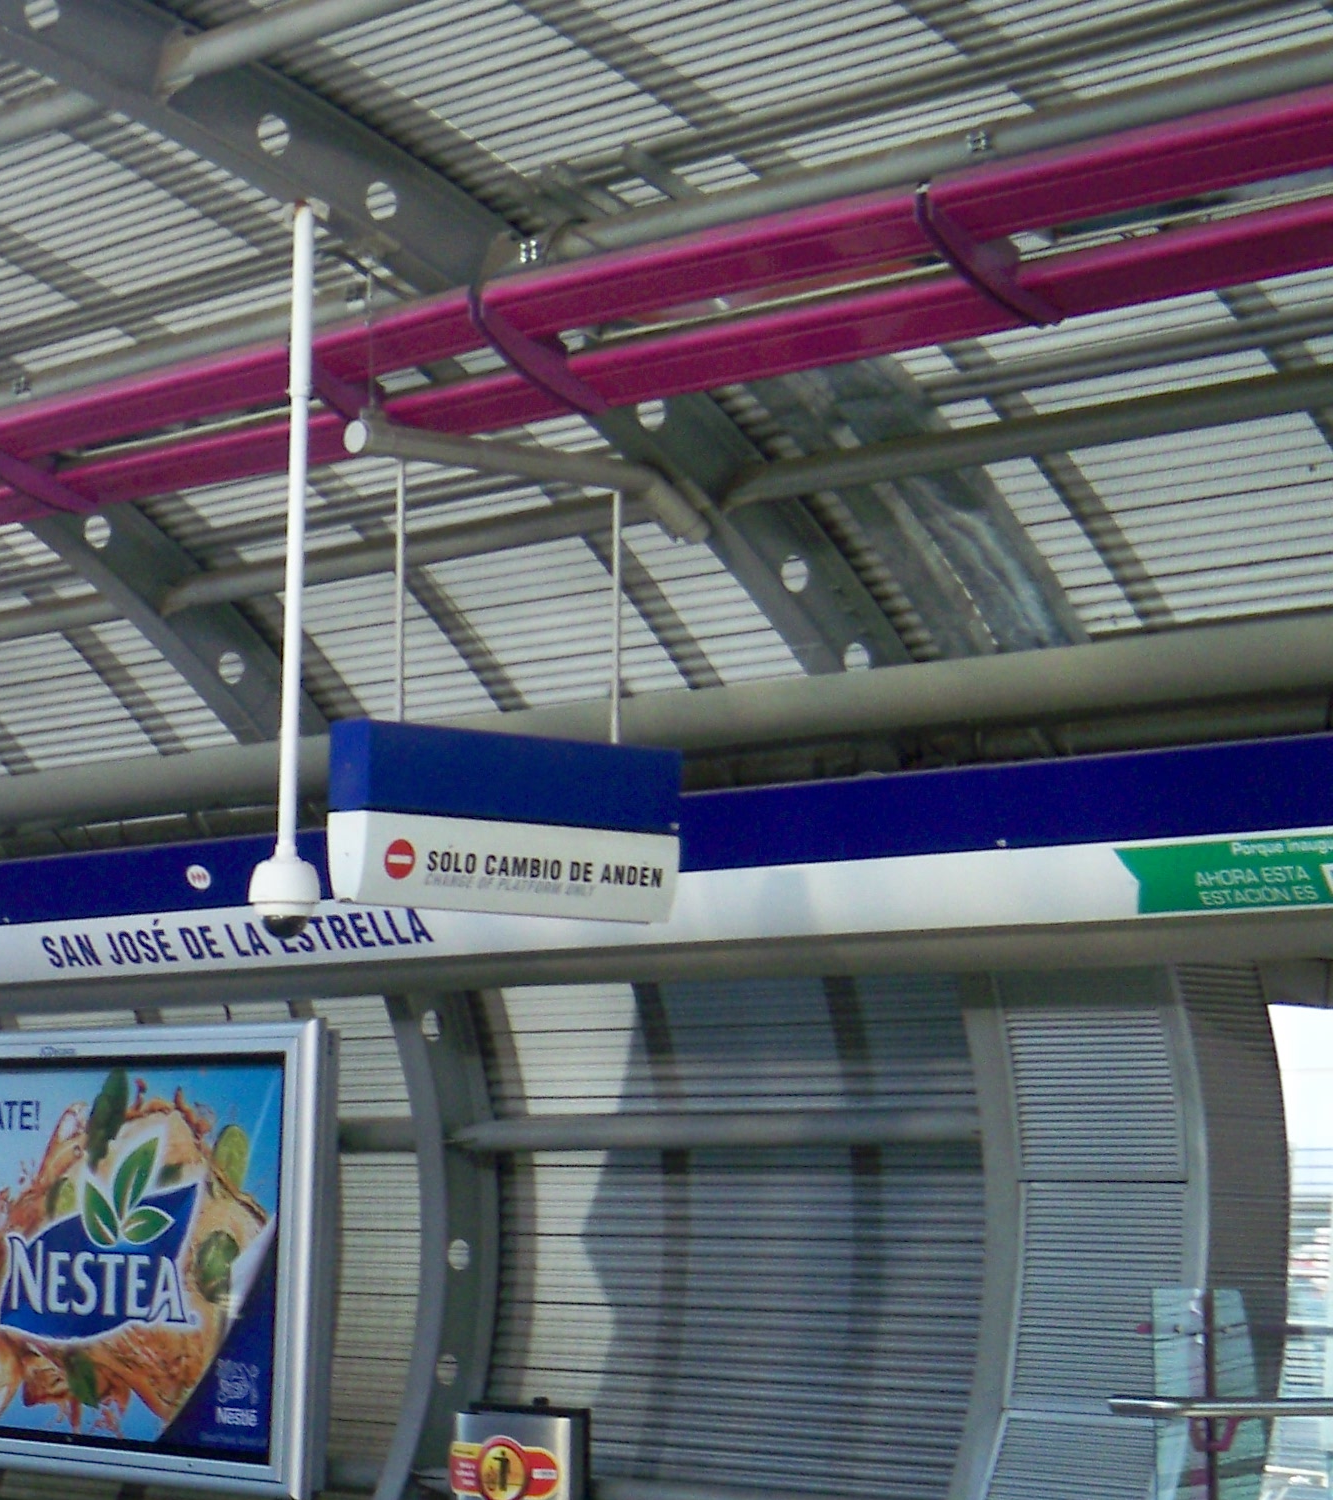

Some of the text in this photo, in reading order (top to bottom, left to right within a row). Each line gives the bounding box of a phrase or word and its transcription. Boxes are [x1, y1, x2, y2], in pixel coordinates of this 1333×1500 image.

[426, 843, 477, 875] SÓLO
[484, 853, 562, 880] CAMBIO
[569, 860, 593, 882] DE
[1195, 865, 1311, 887] AHORA ESTA
[1198, 885, 1319, 906] ESTACIÓN ES
[41, 934, 102, 970] SAN
[107, 918, 178, 966] JOSÉ
[178, 926, 225, 961] DE
[223, 921, 271, 958] LA
[9, 1237, 185, 1322] NESTEA
